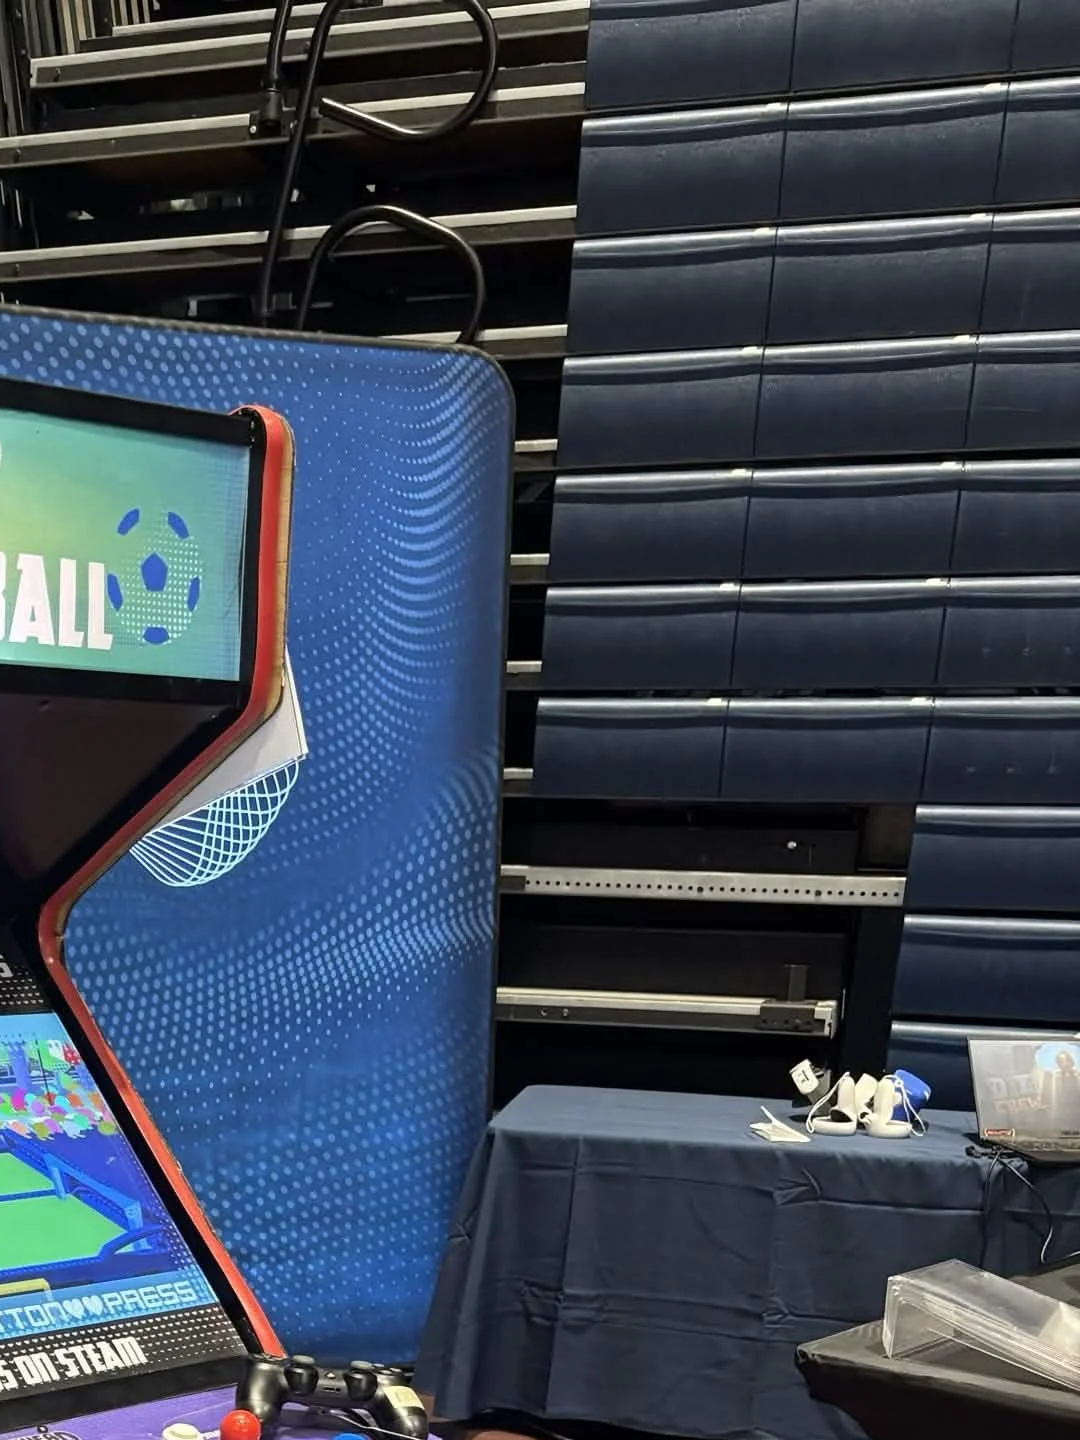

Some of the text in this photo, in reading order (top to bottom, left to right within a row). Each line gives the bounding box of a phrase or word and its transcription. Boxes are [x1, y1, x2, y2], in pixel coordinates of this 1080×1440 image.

[102, 1280, 198, 1314] PRESS
[13, 1351, 60, 1386] ON
[55, 1336, 148, 1379] STEAM
